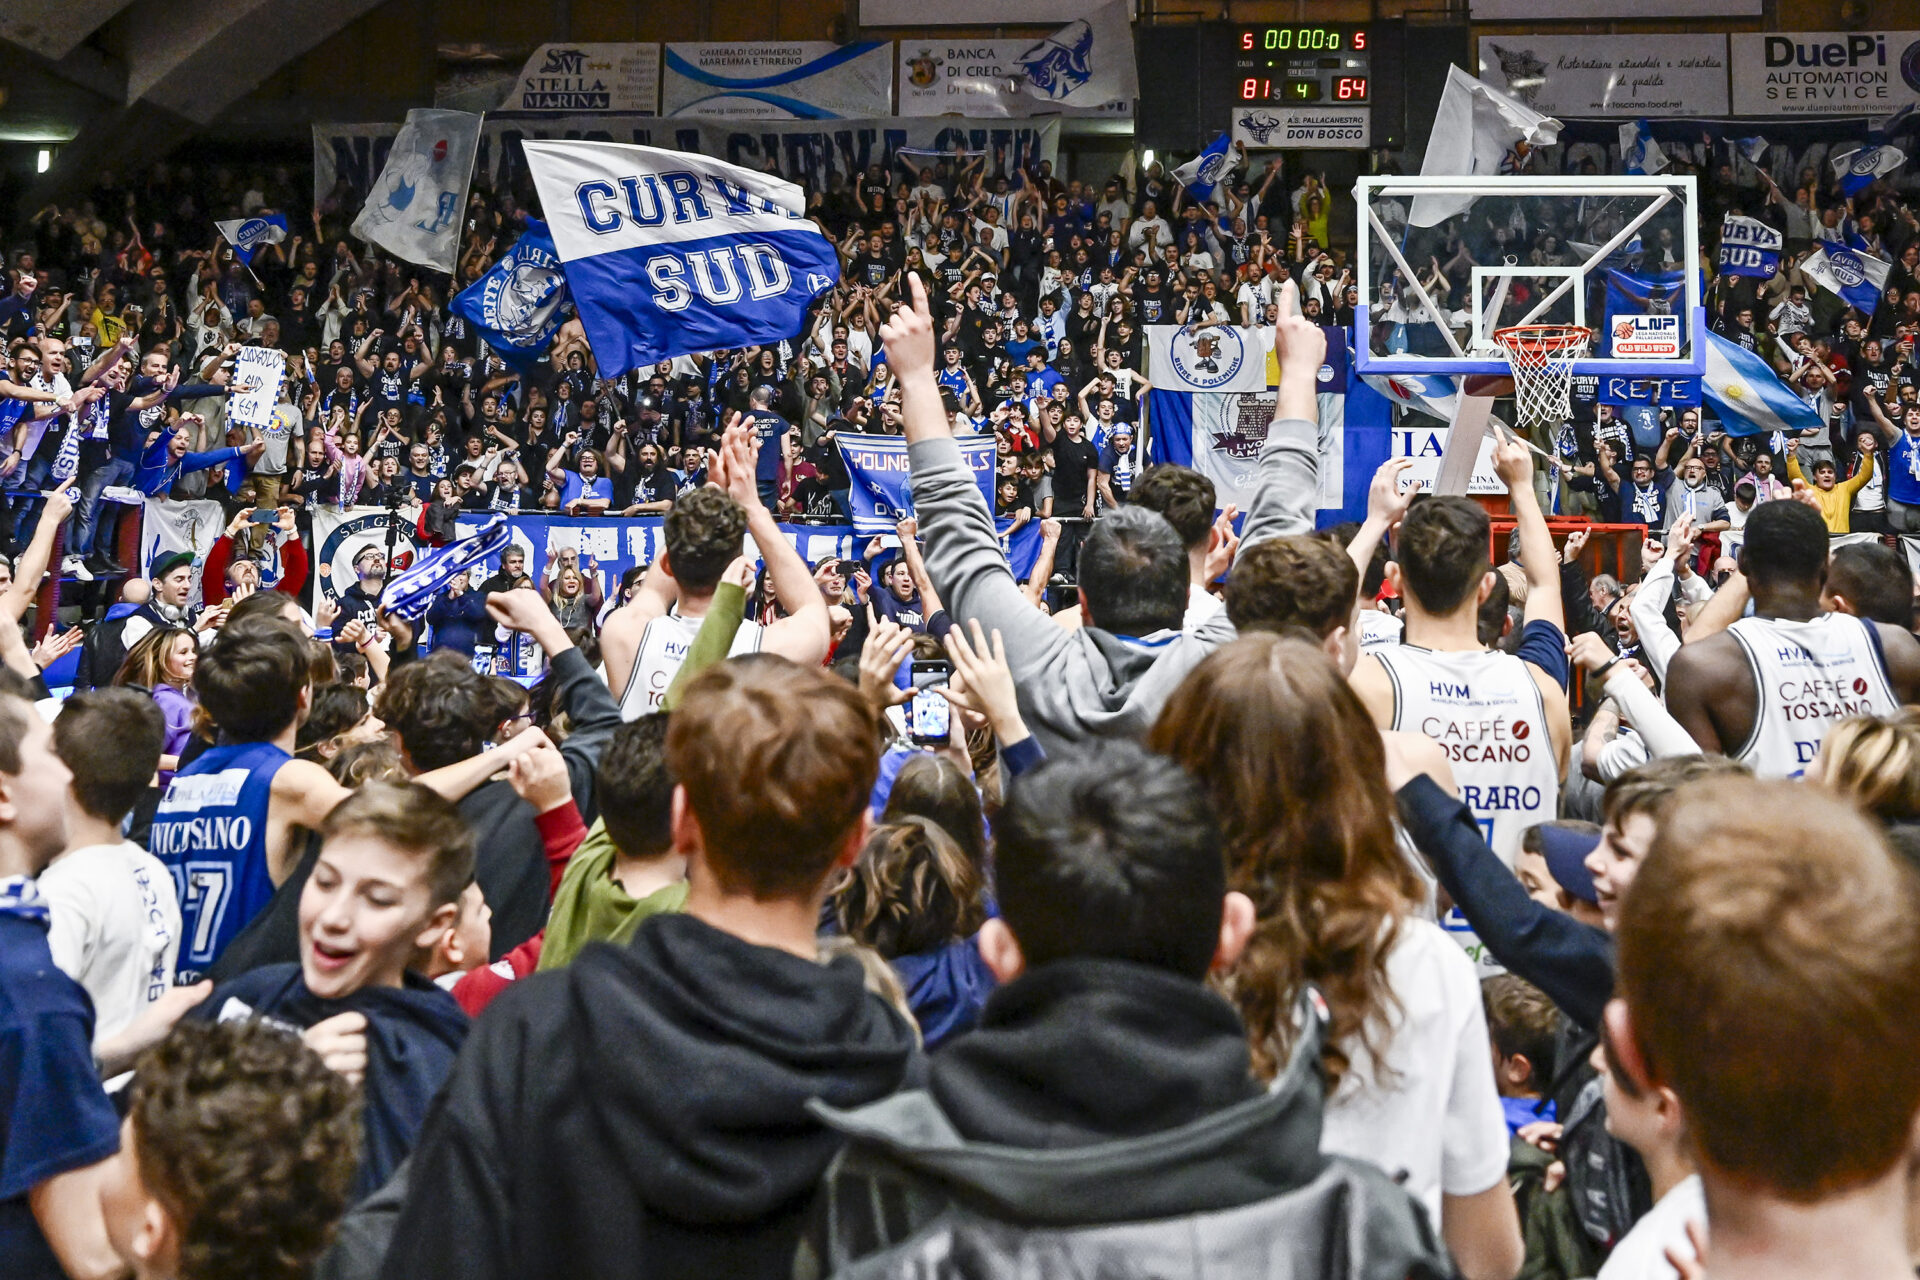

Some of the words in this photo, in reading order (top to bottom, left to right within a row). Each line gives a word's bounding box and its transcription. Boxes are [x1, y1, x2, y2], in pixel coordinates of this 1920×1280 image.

[700, 48, 736, 56] CAMERA
[737, 48, 747, 56] DI
[749, 48, 802, 56] COMMERCIO
[947, 49, 996, 59] BANCA
[1765, 35, 1886, 67] DuePi
[700, 57, 751, 66] MAREMMA
[753, 57, 758, 65] E
[759, 57, 802, 65] TIRRENO
[1556, 56, 1612, 69] Ristorazione
[1618, 55, 1661, 69] aziendale
[947, 66, 961, 77] DI
[1766, 71, 1888, 84] AUTOMATION
[525, 78, 608, 91] STELLA
[1297, 84, 1307, 98] 4
[1338, 78, 1366, 100] 64
[1766, 86, 1888, 99] SERVICE
[525, 93, 607, 109] MARINA
[1287, 116, 1301, 124] A.S.
[1302, 116, 1364, 124] PALLACANESTRO
[1286, 129, 1315, 140] DON
[1317, 129, 1363, 140] BOSCO
[238, 222, 265, 240] CURVA
[1722, 223, 1777, 245] URVA
[645, 242, 792, 313] SUD
[1635, 318, 1676, 330] LNP
[1174, 357, 1192, 379] BIRRE
[1202, 357, 1240, 385] POLEMICHE
[1570, 376, 1600, 386] CURVA
[1608, 378, 1691, 400] RETE
[1236, 439, 1265, 450] LIVO
[850, 451, 910, 472] YOUNG
[340, 520, 371, 539] SEZ.
[1430, 681, 1470, 700] HVM
[1421, 715, 1506, 741] CAFFÉ
[1458, 785, 1541, 811] RARO
